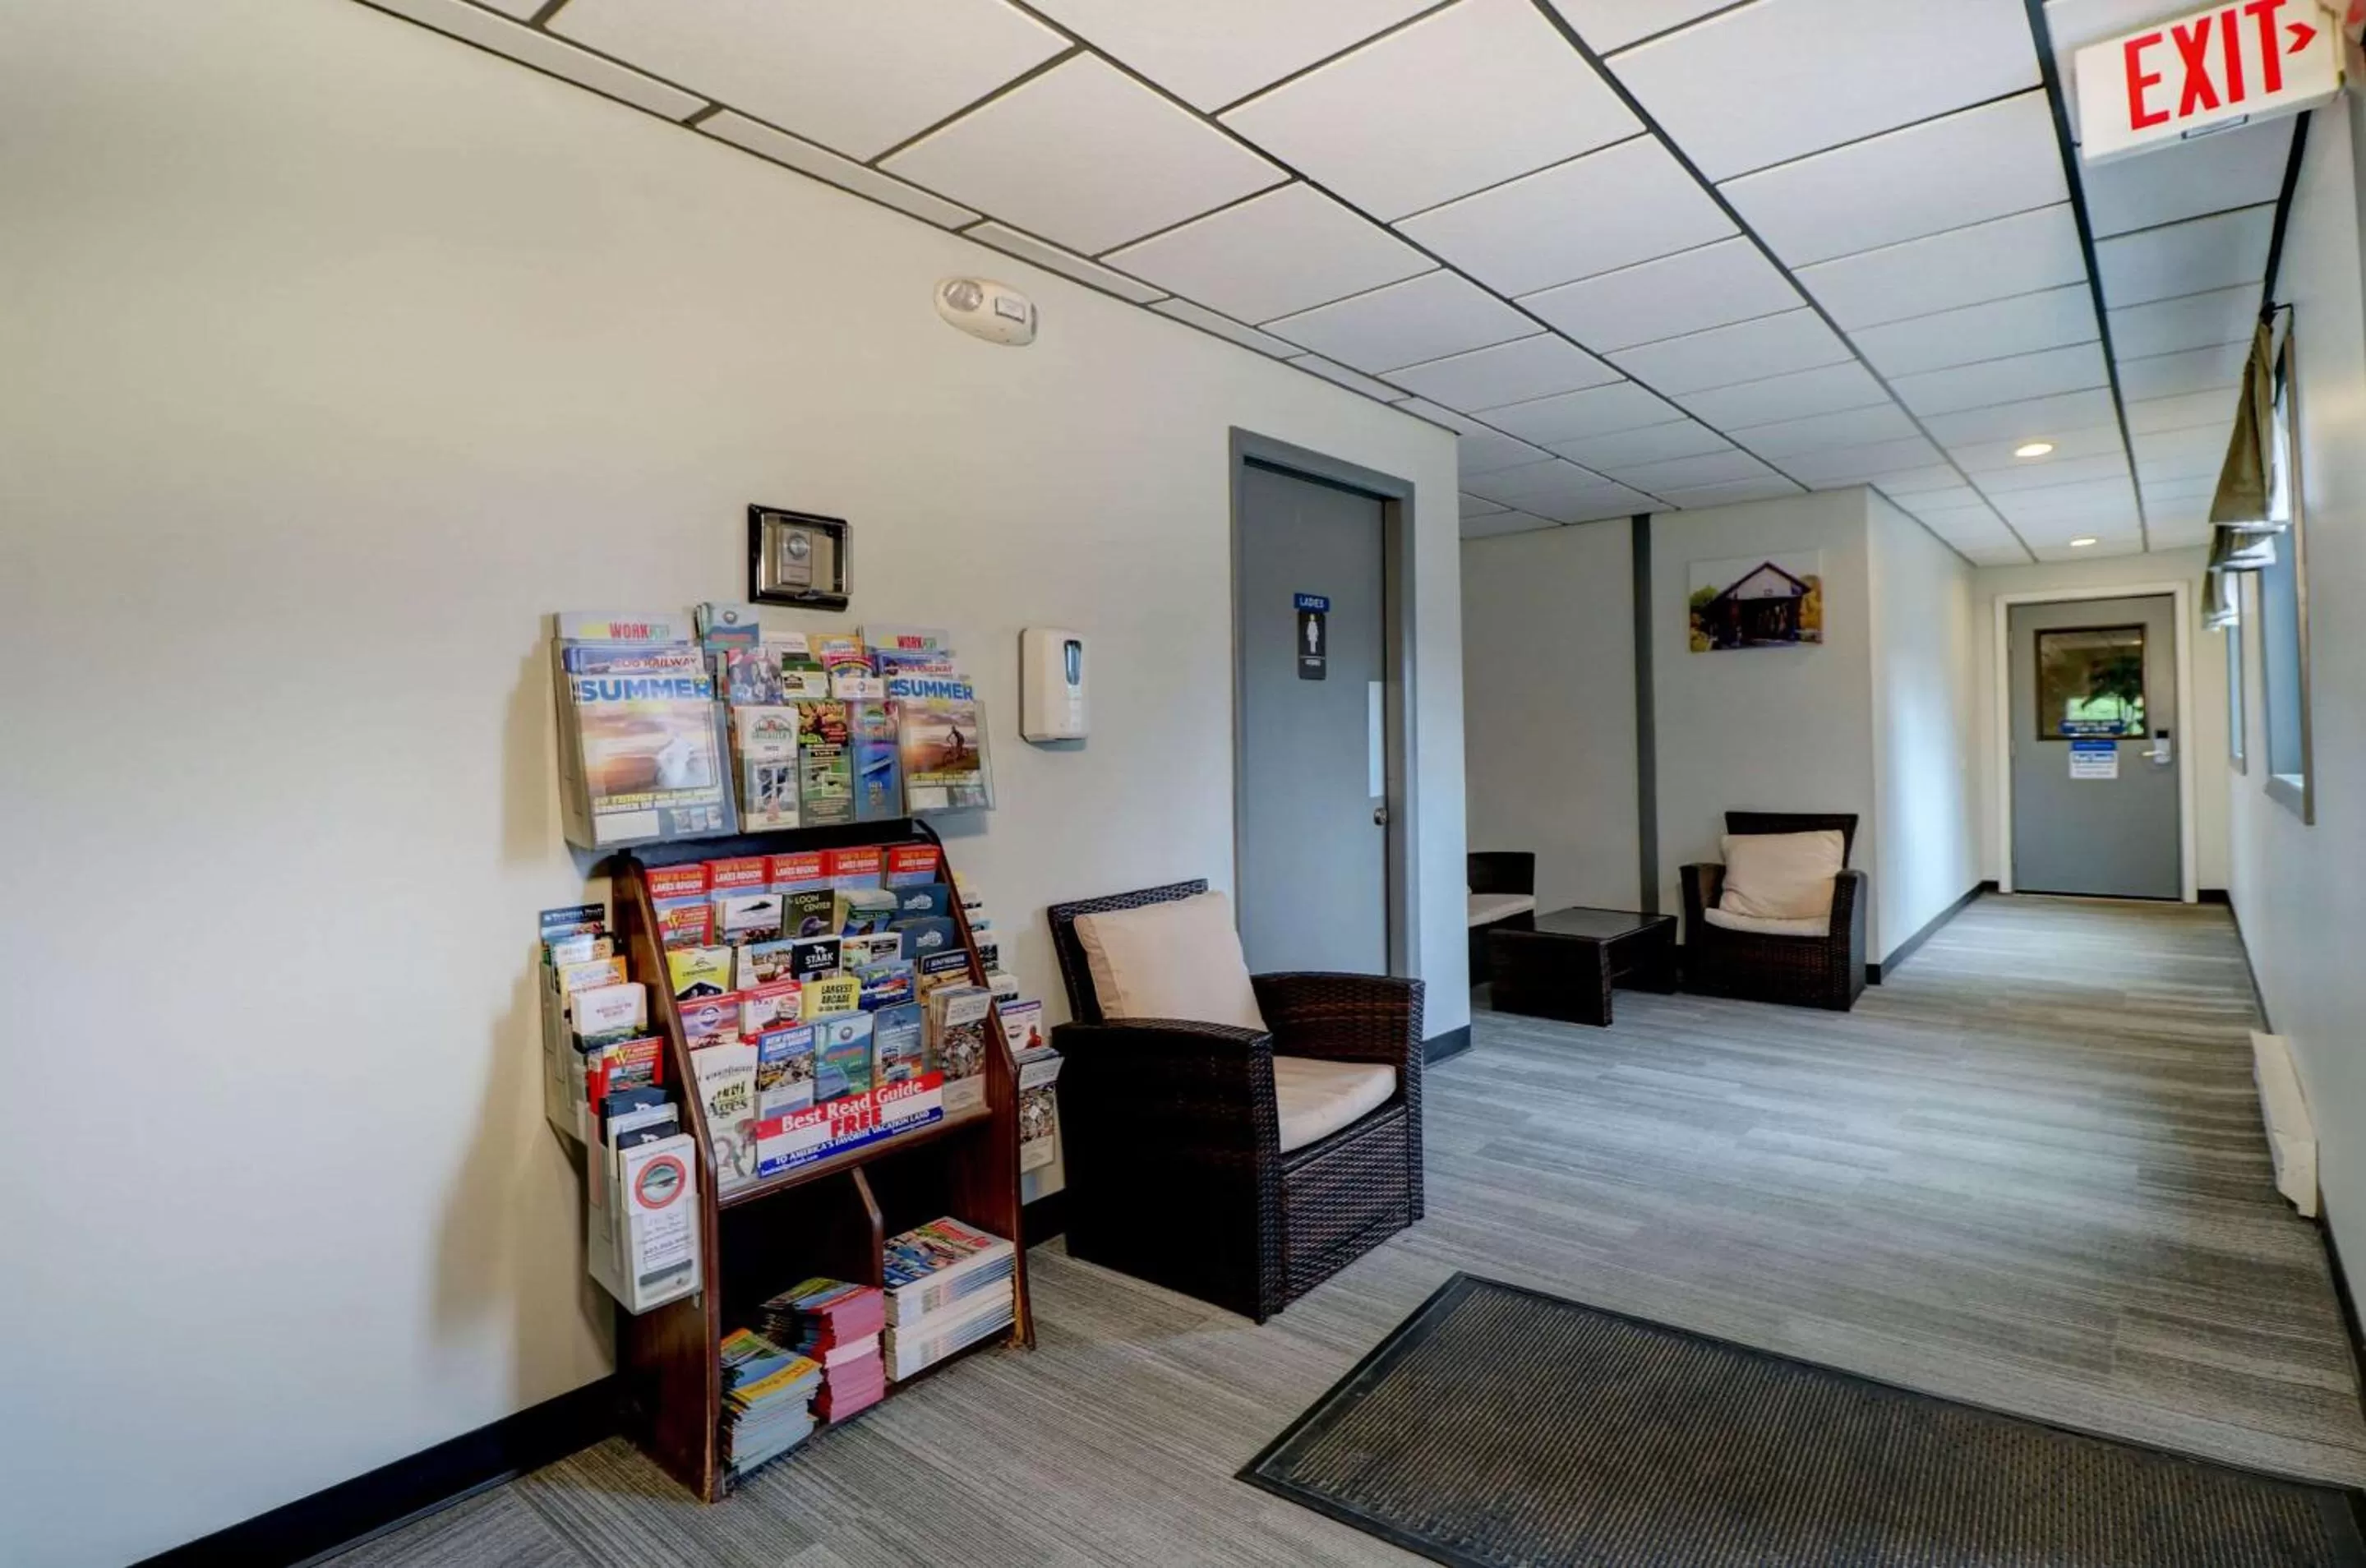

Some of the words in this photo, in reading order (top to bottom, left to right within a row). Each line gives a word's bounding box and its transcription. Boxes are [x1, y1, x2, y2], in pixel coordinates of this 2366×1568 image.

[2123, 0, 2289, 131] EXIT
[610, 622, 649, 639] WORK
[643, 656, 697, 668] RAILWAY
[580, 677, 713, 703] SUMMER
[897, 679, 974, 700] SUMMER
[795, 893, 820, 905] LOON
[804, 902, 832, 912] CENTER
[805, 953, 834, 965] STARK
[821, 984, 853, 994] LARGEST
[822, 994, 851, 1005] ARCADE
[782, 1108, 822, 1131] Best
[827, 1092, 871, 1119] Read
[876, 1077, 925, 1103] Guide
[830, 1107, 883, 1137] FREE
[776, 1155, 788, 1165] TO
[789, 1137, 835, 1160] AMERICA'S
[871, 1118, 909, 1134] VACATION
[910, 1109, 930, 1123] LAND
